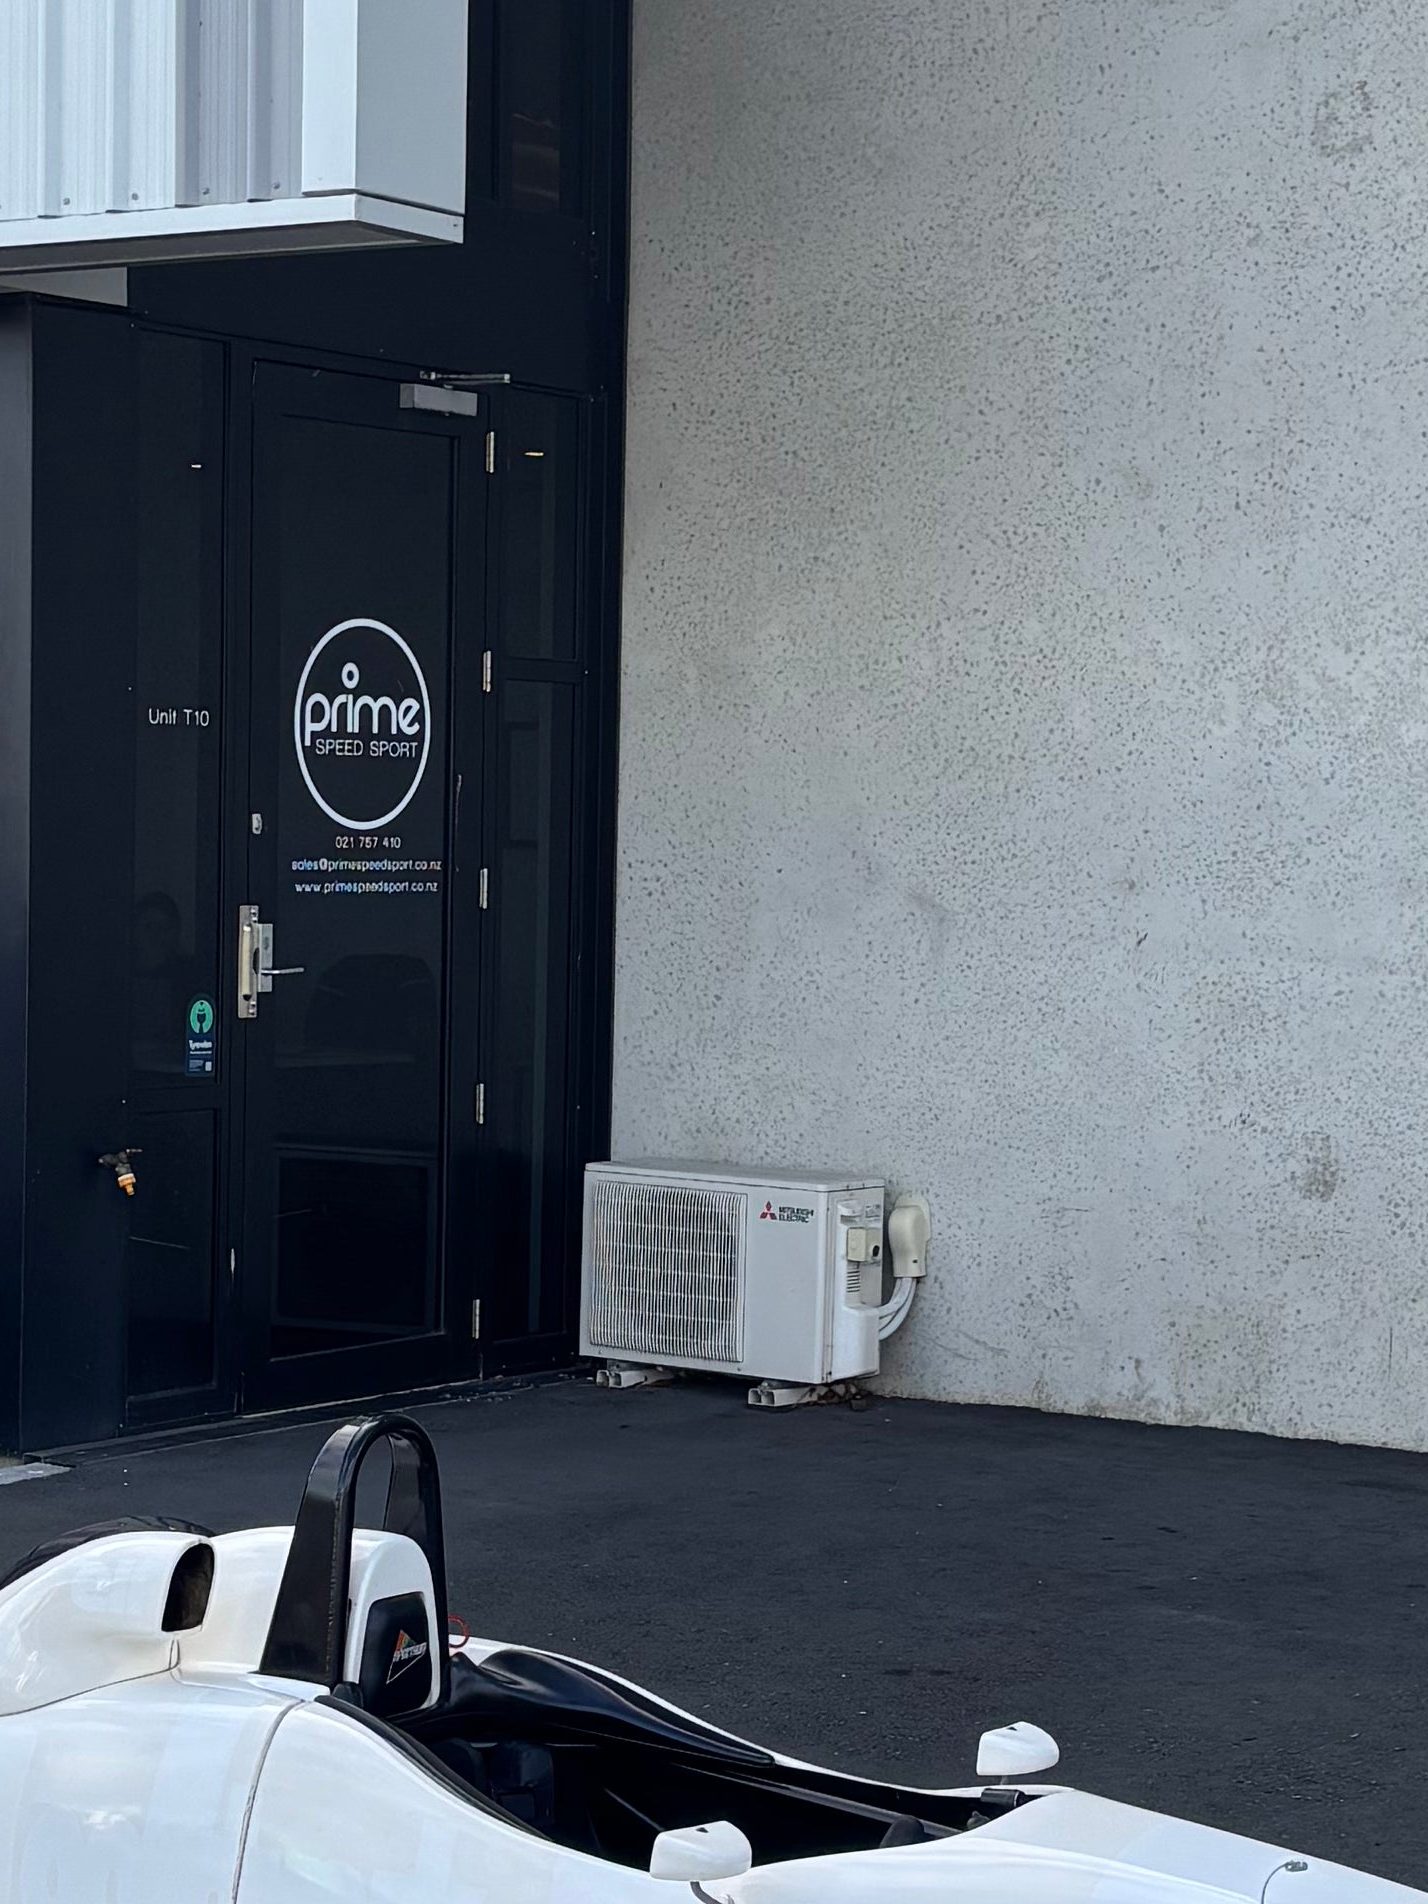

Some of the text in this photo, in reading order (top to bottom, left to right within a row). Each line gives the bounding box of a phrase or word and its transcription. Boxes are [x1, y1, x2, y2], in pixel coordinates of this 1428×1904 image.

[304, 662, 421, 747] prime
[148, 708, 210, 727] Unit T10
[315, 738, 419, 758] SPEED SPORT
[335, 836, 354, 849] 021
[383, 836, 401, 849] 410
[291, 858, 442, 873] sales@primespeedsport.co.nz
[294, 880, 438, 895] www.primespeedsport.co.nz
